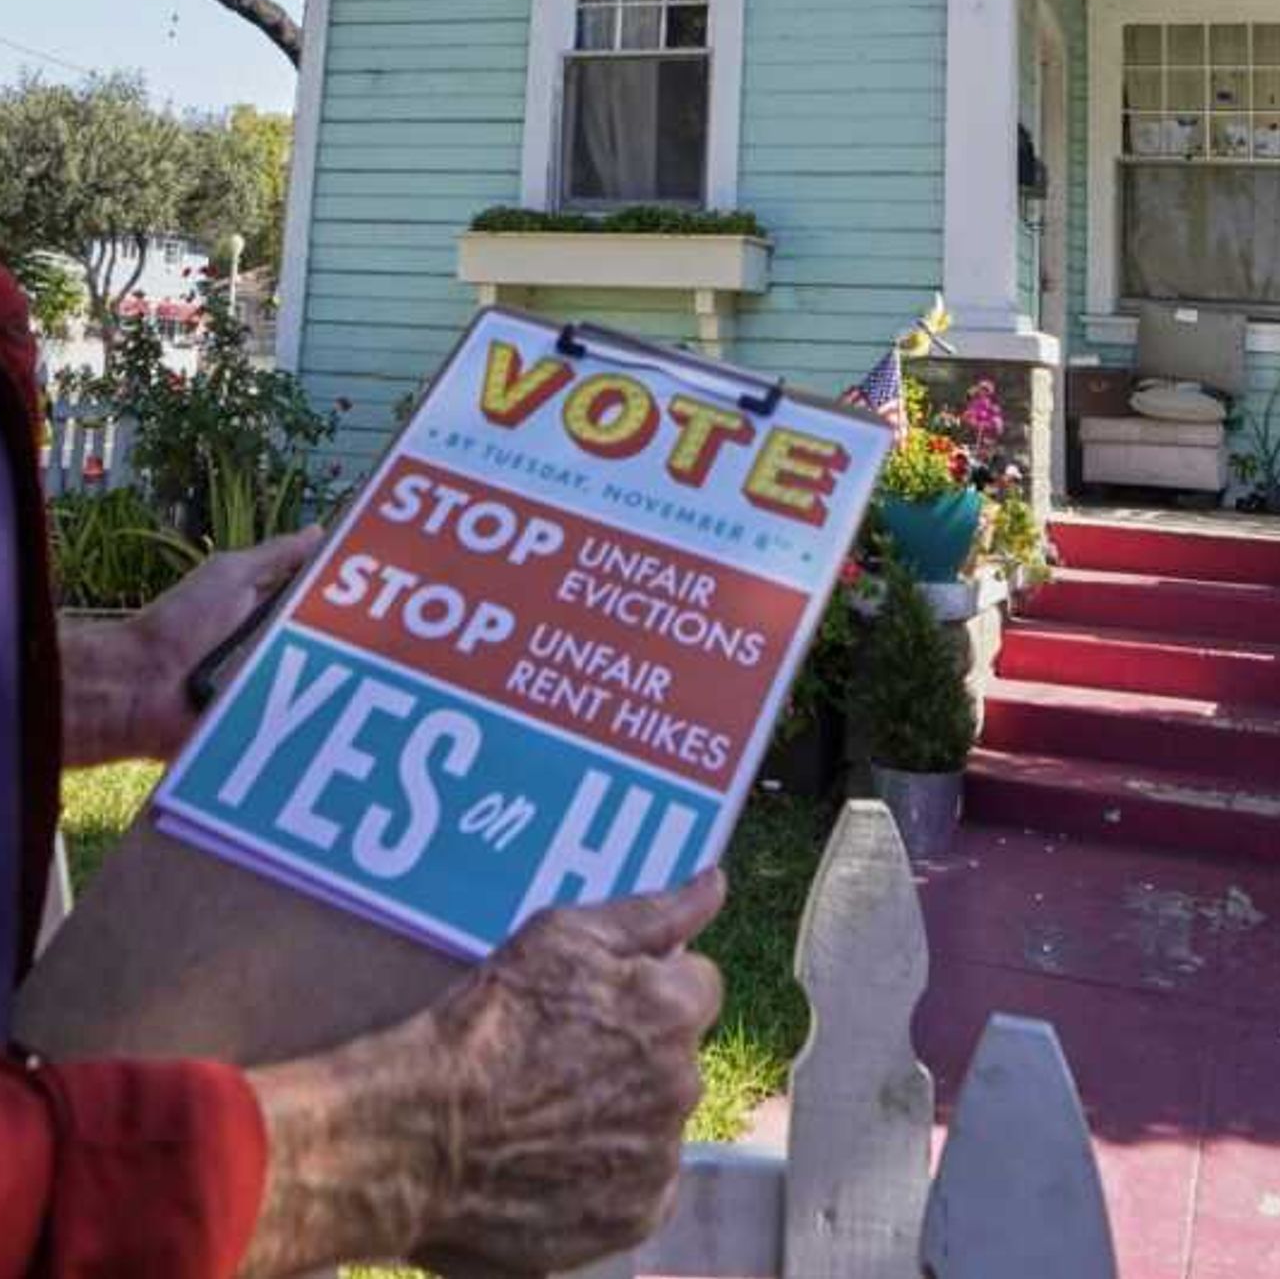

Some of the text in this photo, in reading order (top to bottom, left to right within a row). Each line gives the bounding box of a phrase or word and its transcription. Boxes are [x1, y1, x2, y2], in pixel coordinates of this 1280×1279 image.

[479, 337, 852, 527] VOTE
[379, 474, 565, 566] STOP
[602, 483, 746, 542] NOVEMBER
[322, 554, 516, 653] STOP
[557, 570, 765, 666] EVICTIONS
[578, 537, 717, 608] UNFAIR
[528, 623, 672, 703] UNFAIR
[217, 644, 483, 878] YES
[458, 791, 538, 851] on
[505, 659, 731, 770] RENT HIKES
